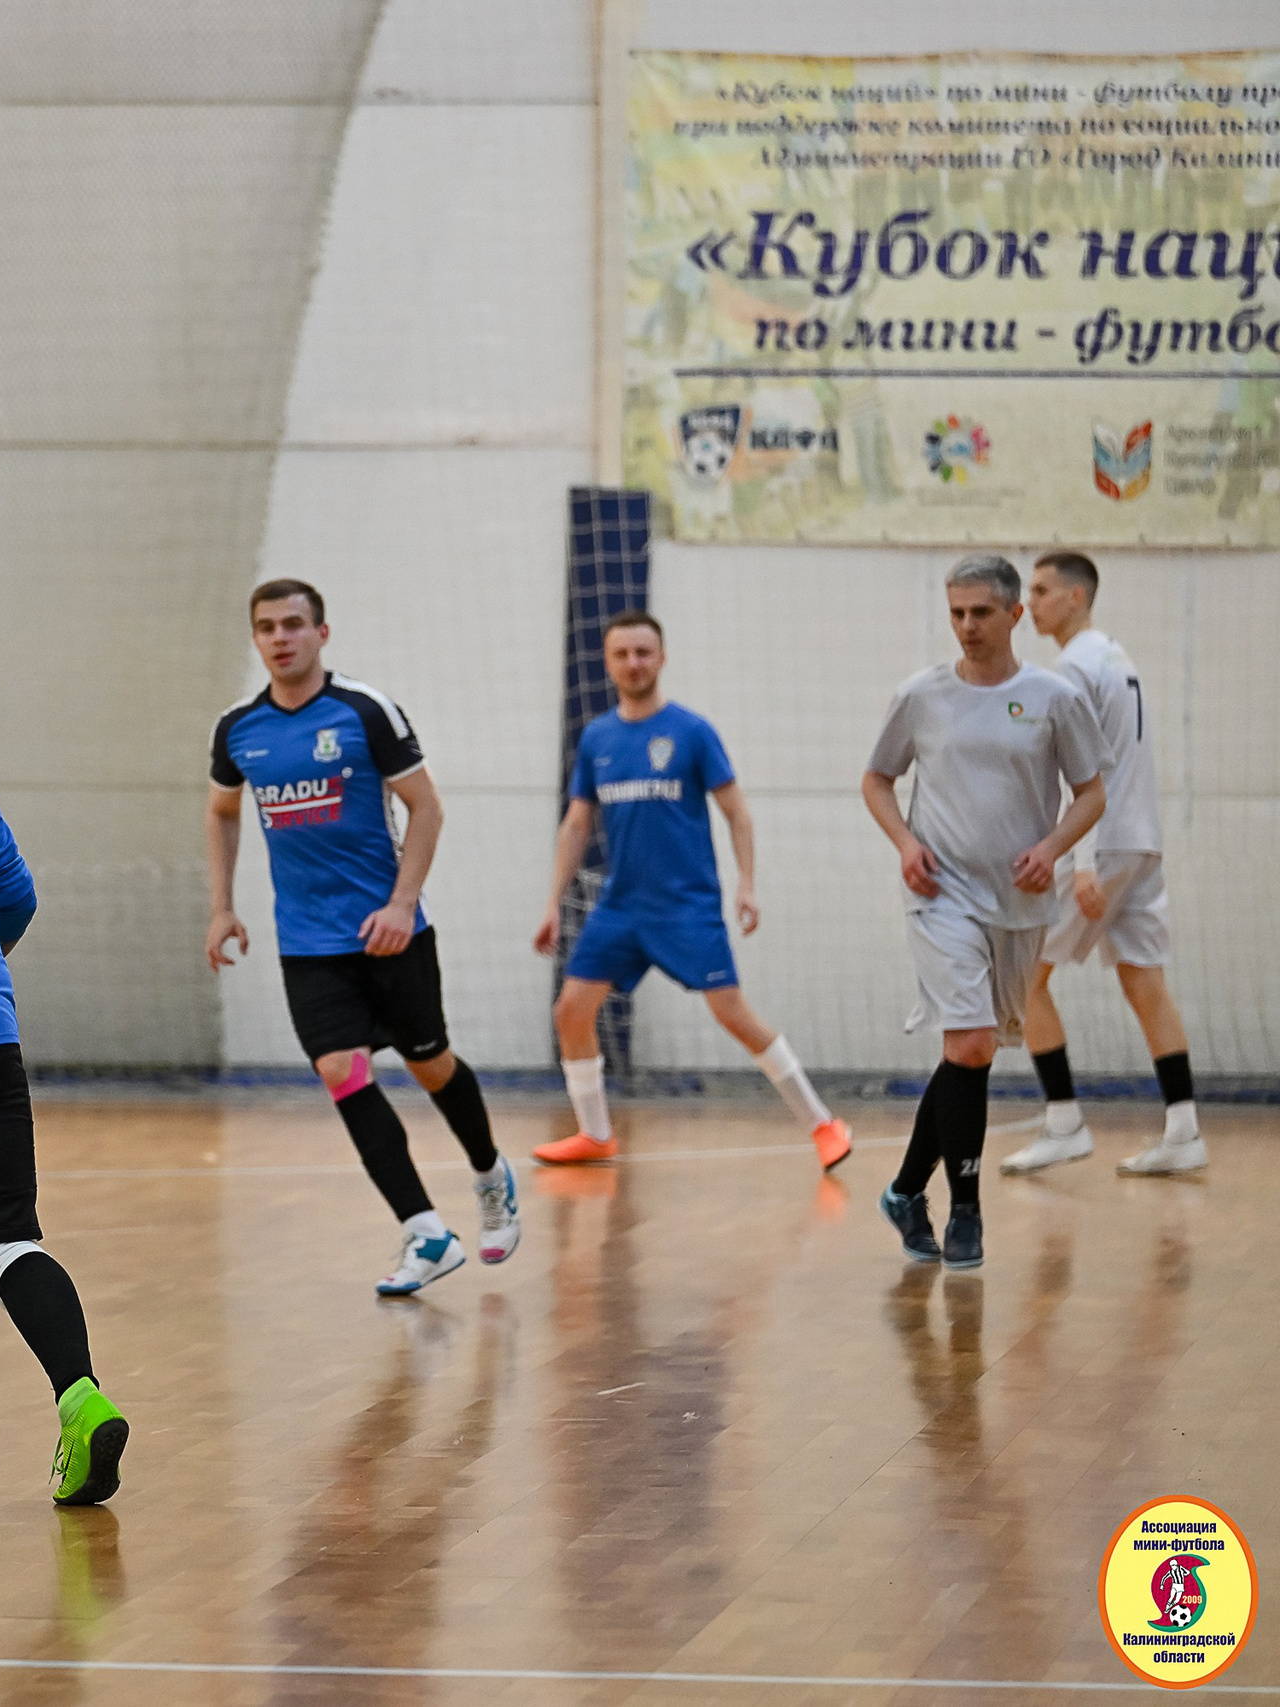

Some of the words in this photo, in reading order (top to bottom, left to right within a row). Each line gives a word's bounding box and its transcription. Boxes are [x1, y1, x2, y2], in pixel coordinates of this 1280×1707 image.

[687, 209, 1049, 298] «Кубок
[754, 317, 828, 350] по
[842, 317, 1017, 351] мини
